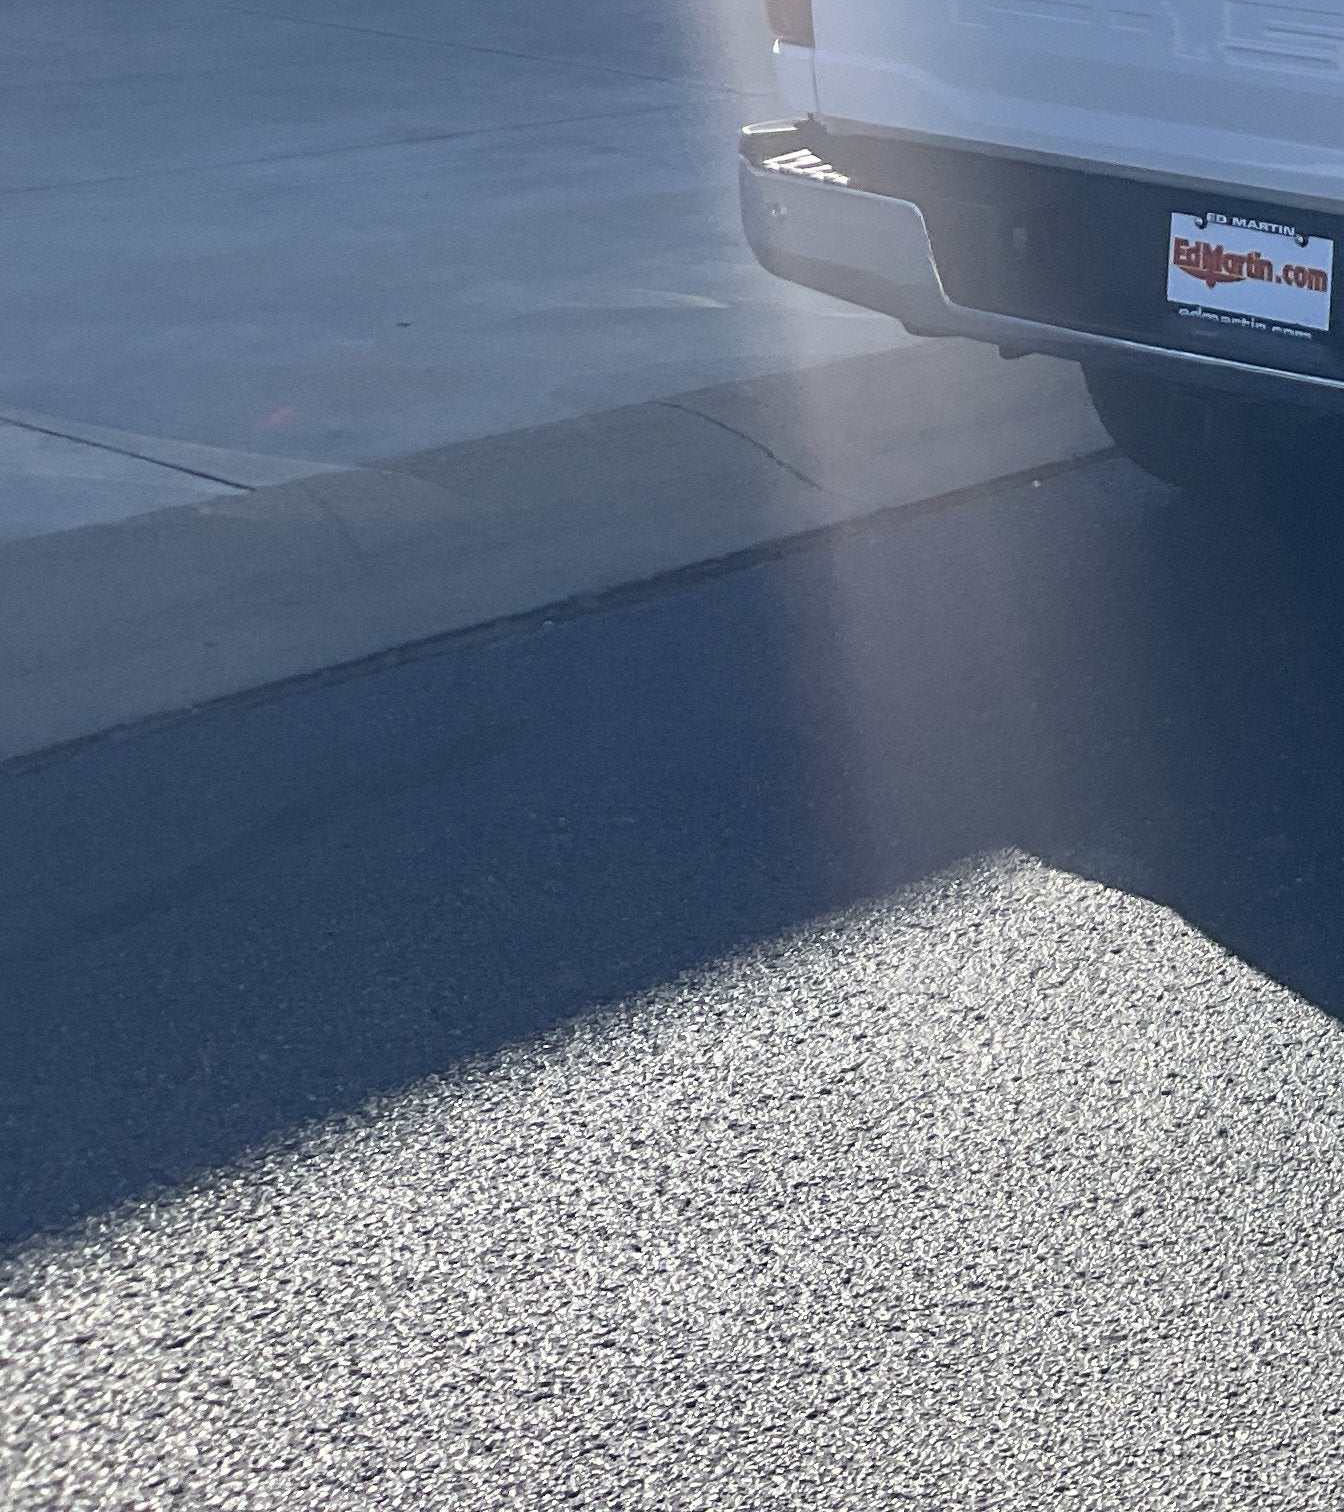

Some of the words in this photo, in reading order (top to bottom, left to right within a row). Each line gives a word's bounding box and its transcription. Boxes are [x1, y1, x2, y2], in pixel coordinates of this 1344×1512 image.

[1206, 212, 1228, 224] ED
[1231, 216, 1296, 236] MARTIN
[1172, 236, 1329, 293] EdMartin.com
